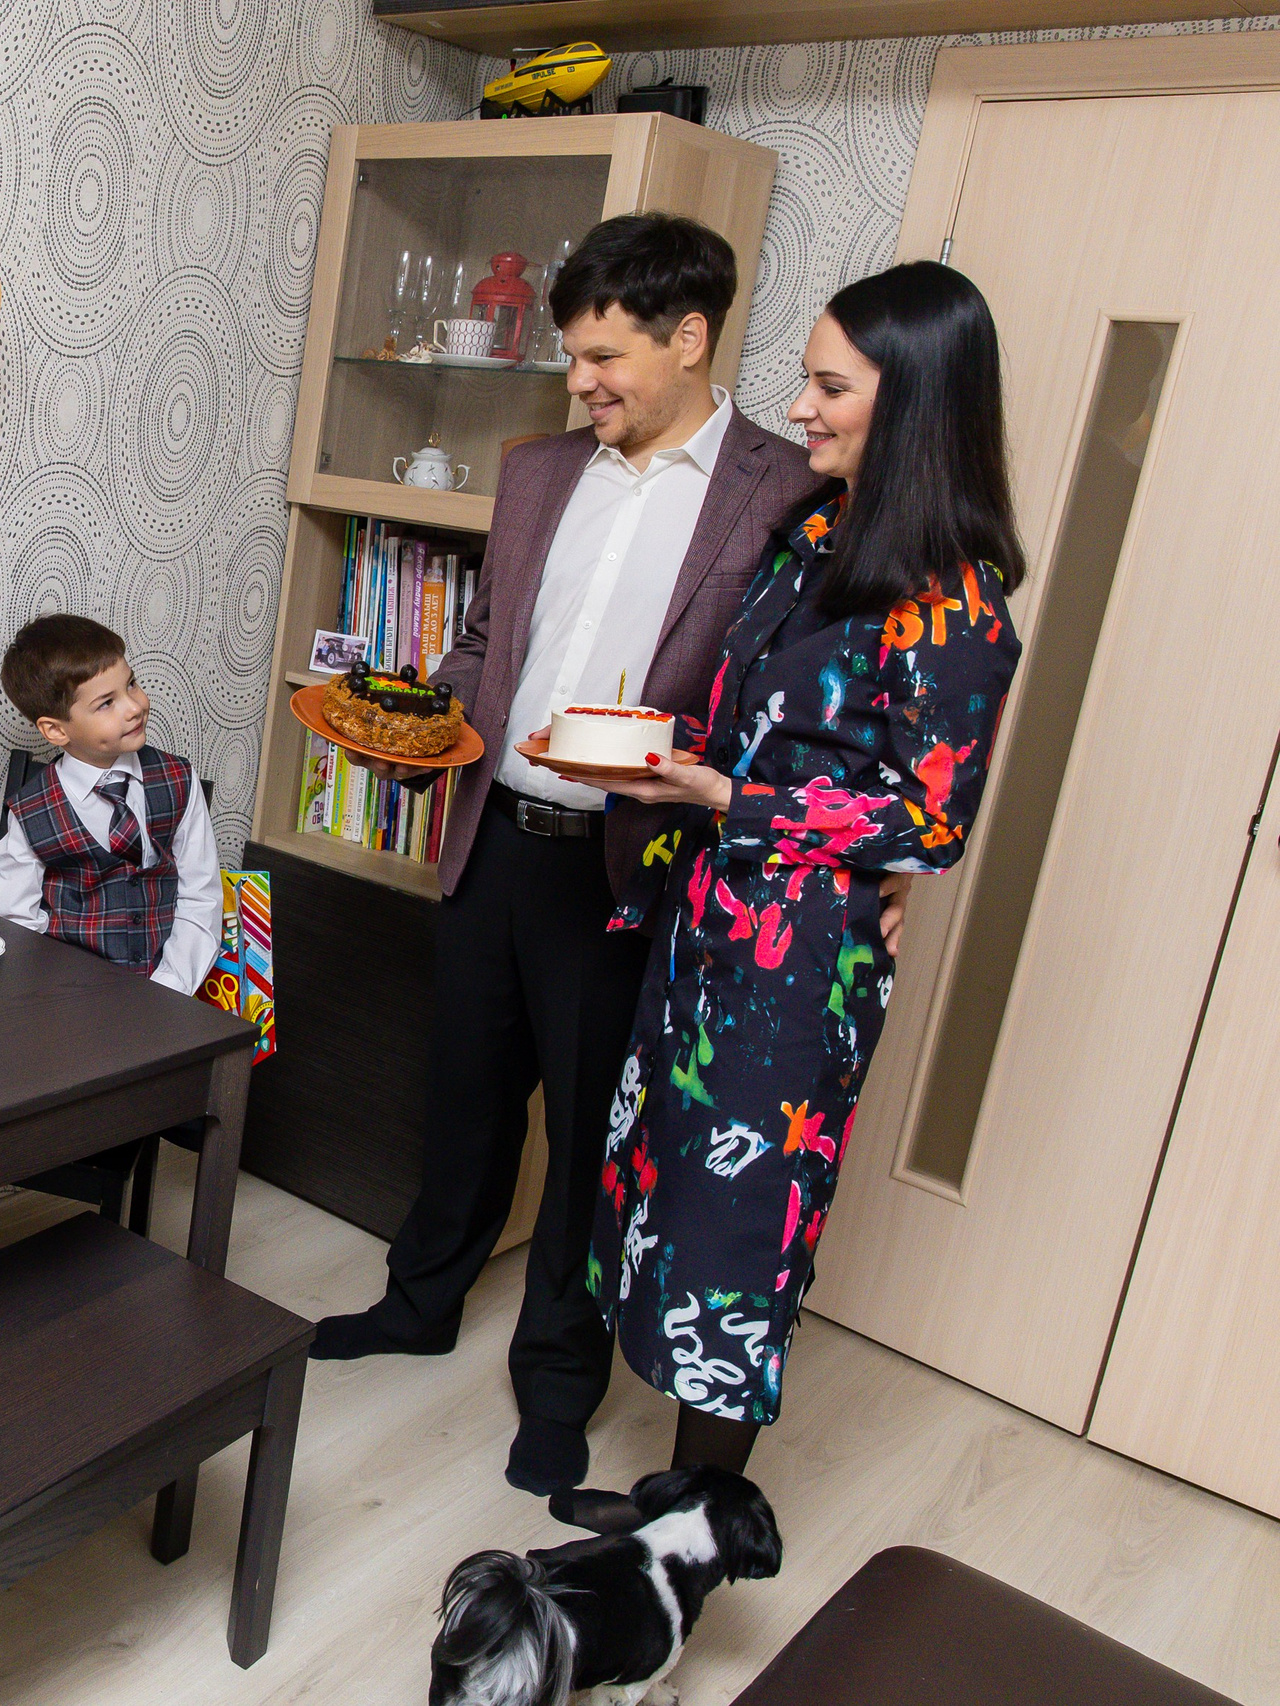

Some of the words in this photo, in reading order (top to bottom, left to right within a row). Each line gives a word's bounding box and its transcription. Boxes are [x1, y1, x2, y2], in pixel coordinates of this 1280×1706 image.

[418, 546, 426, 555] Я
[416, 555, 425, 580] скоро
[387, 586, 396, 616] МАКИЯЖ
[413, 581, 423, 608] стану
[431, 594, 439, 611] ЛЕТ
[423, 593, 432, 630] МАЛЫШ
[412, 608, 421, 638] мамой
[430, 620, 438, 633] ДО
[386, 626, 395, 644] БРАУН
[422, 633, 430, 655] ВАШ
[429, 641, 437, 655] ОТ
